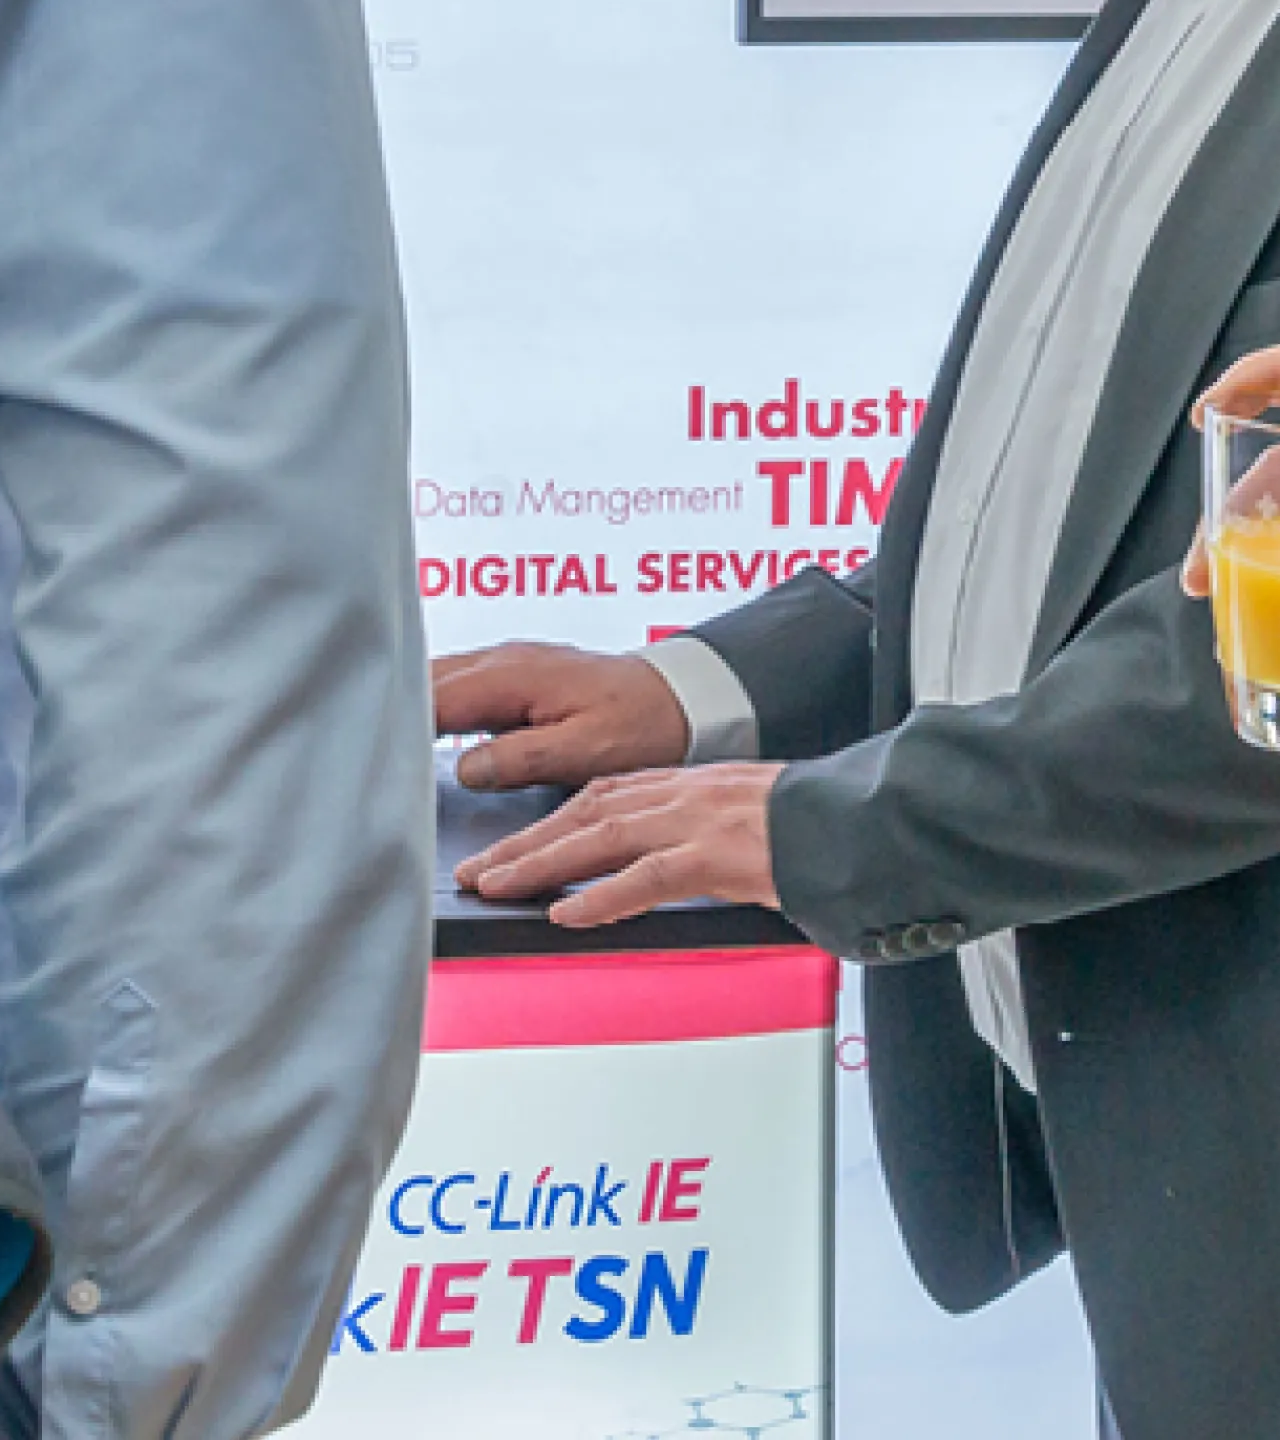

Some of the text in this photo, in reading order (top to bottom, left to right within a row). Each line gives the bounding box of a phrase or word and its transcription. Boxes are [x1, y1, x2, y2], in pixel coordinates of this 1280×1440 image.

[415, 477, 744, 525] Data Mangement
[420, 551, 617, 597] DIGITAL
[638, 1156, 713, 1224] IE
[387, 1259, 491, 1352] IE
[508, 1247, 710, 1344] TSN
